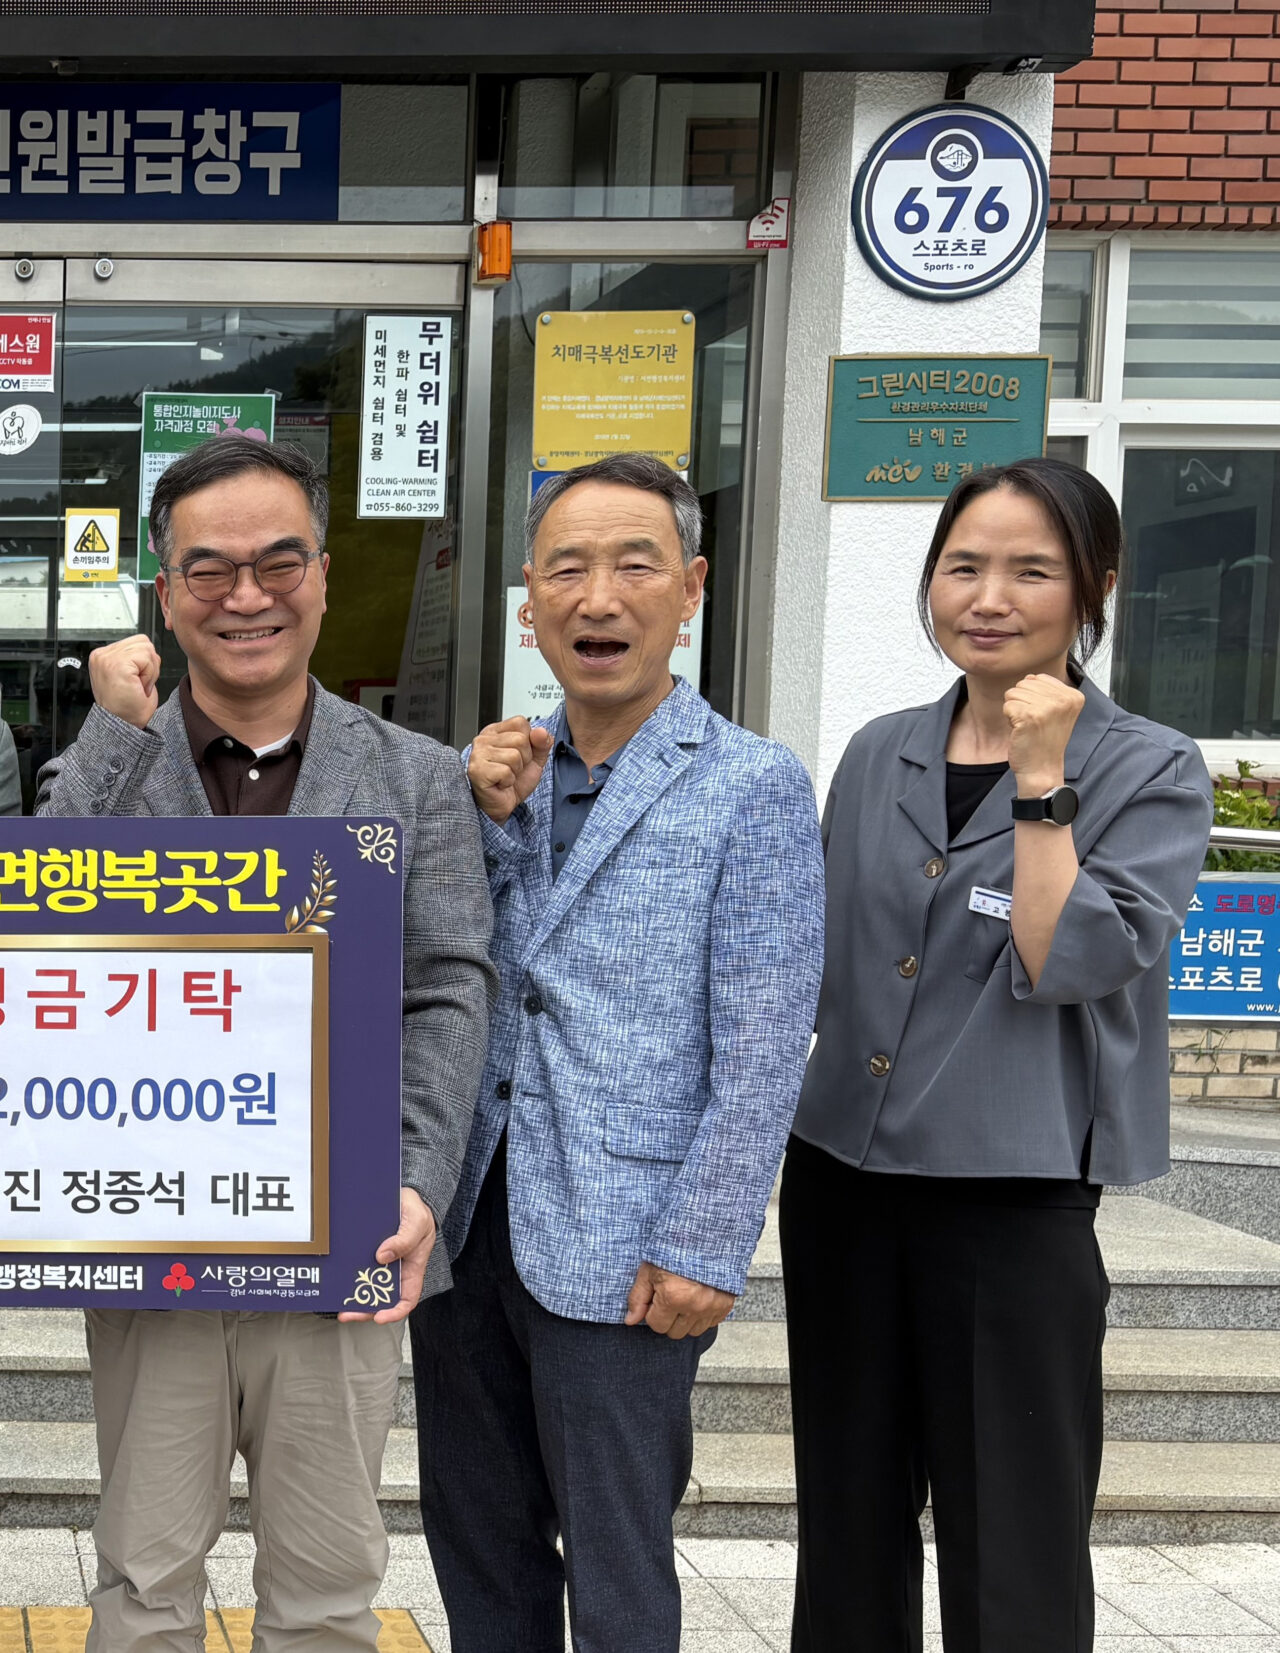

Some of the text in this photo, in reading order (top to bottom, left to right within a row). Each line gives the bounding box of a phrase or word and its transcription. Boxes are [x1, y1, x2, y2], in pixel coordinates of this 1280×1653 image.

[894, 186, 1010, 235] 676
[912, 239, 987, 257] 스포츠로
[923, 262, 954, 272] Sports
[551, 344, 678, 364] 치매극복선도기관
[395, 350, 410, 438] 한파 쉼터 및
[857, 370, 1020, 400] 그린시티2008
[370, 329, 387, 461] 미세먼지 쉼터 겸용
[416, 321, 443, 474] 무더위 쉼터
[153, 404, 241, 419] 통합인지놀이지도사
[890, 401, 988, 413] 환경관리우수자치단체
[153, 419, 217, 433] 자격과정 모집
[908, 428, 968, 446] 남해군
[365, 477, 438, 486] COOLING-WARMING
[366, 488, 436, 497] CLEAN AIR CENTER
[373, 502, 440, 512] 055-860-3299
[72, 555, 110, 565] 손끼임주의
[1180, 928, 1265, 957] 남해군
[61, 1169, 187, 1217] 정종석
[209, 1172, 294, 1217] 대표
[200, 1265, 320, 1288] 사랑의열매
[230, 1288, 320, 1298] 경남 사회복지공동모금회
